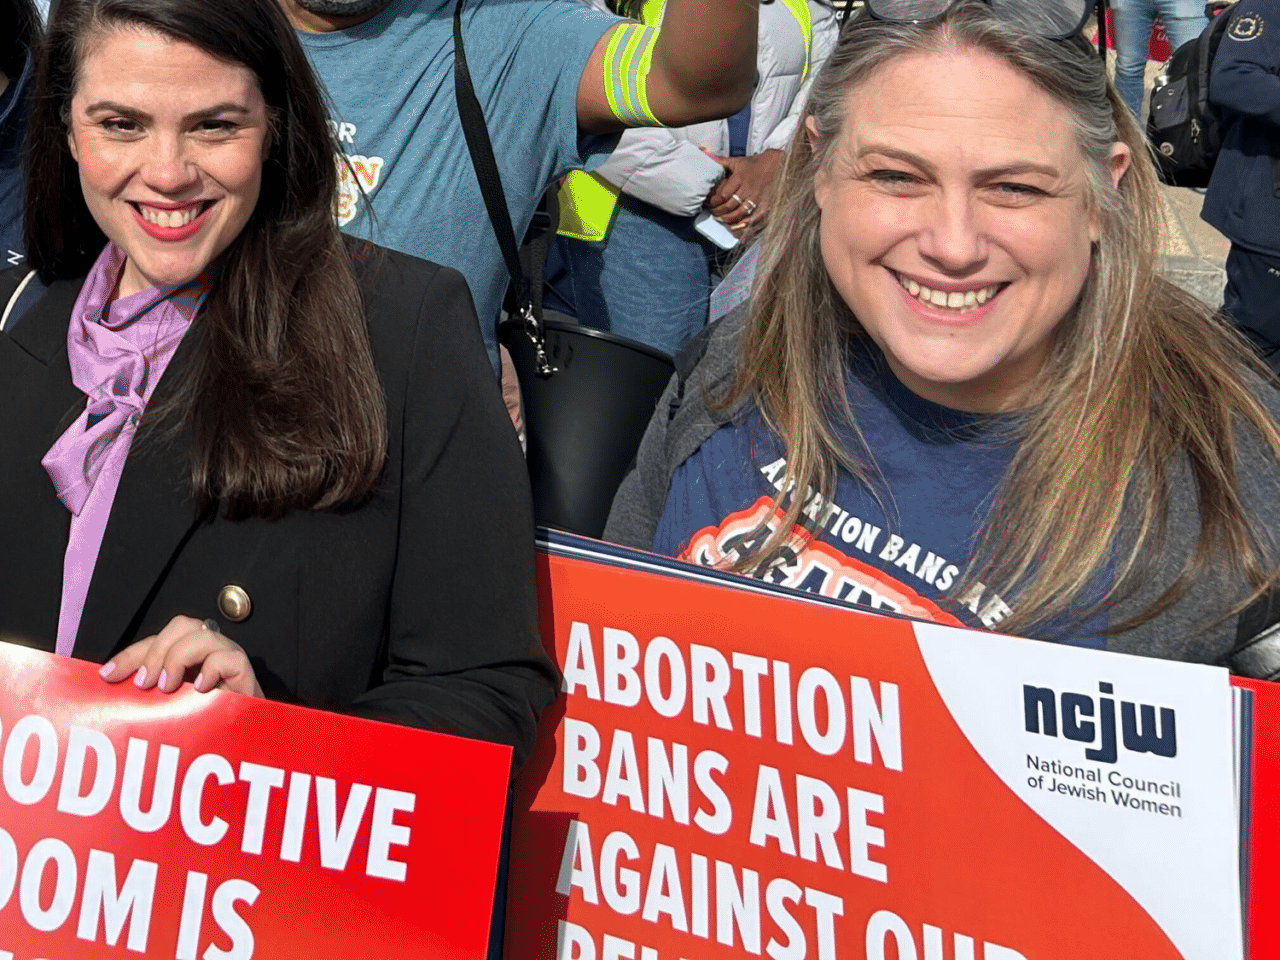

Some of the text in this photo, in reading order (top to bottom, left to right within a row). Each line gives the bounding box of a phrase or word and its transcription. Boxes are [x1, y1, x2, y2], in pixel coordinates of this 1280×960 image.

[879, 534, 960, 591] BANS
[563, 622, 904, 772] ABORTION
[1023, 681, 1177, 764] ncjw
[563, 717, 888, 884] BANS ARE
[1026, 754, 1182, 799] National Council
[1027, 776, 1182, 818] of Jewish Women
[176, 871, 262, 960] IS
[555, 819, 845, 960] AGAINST
